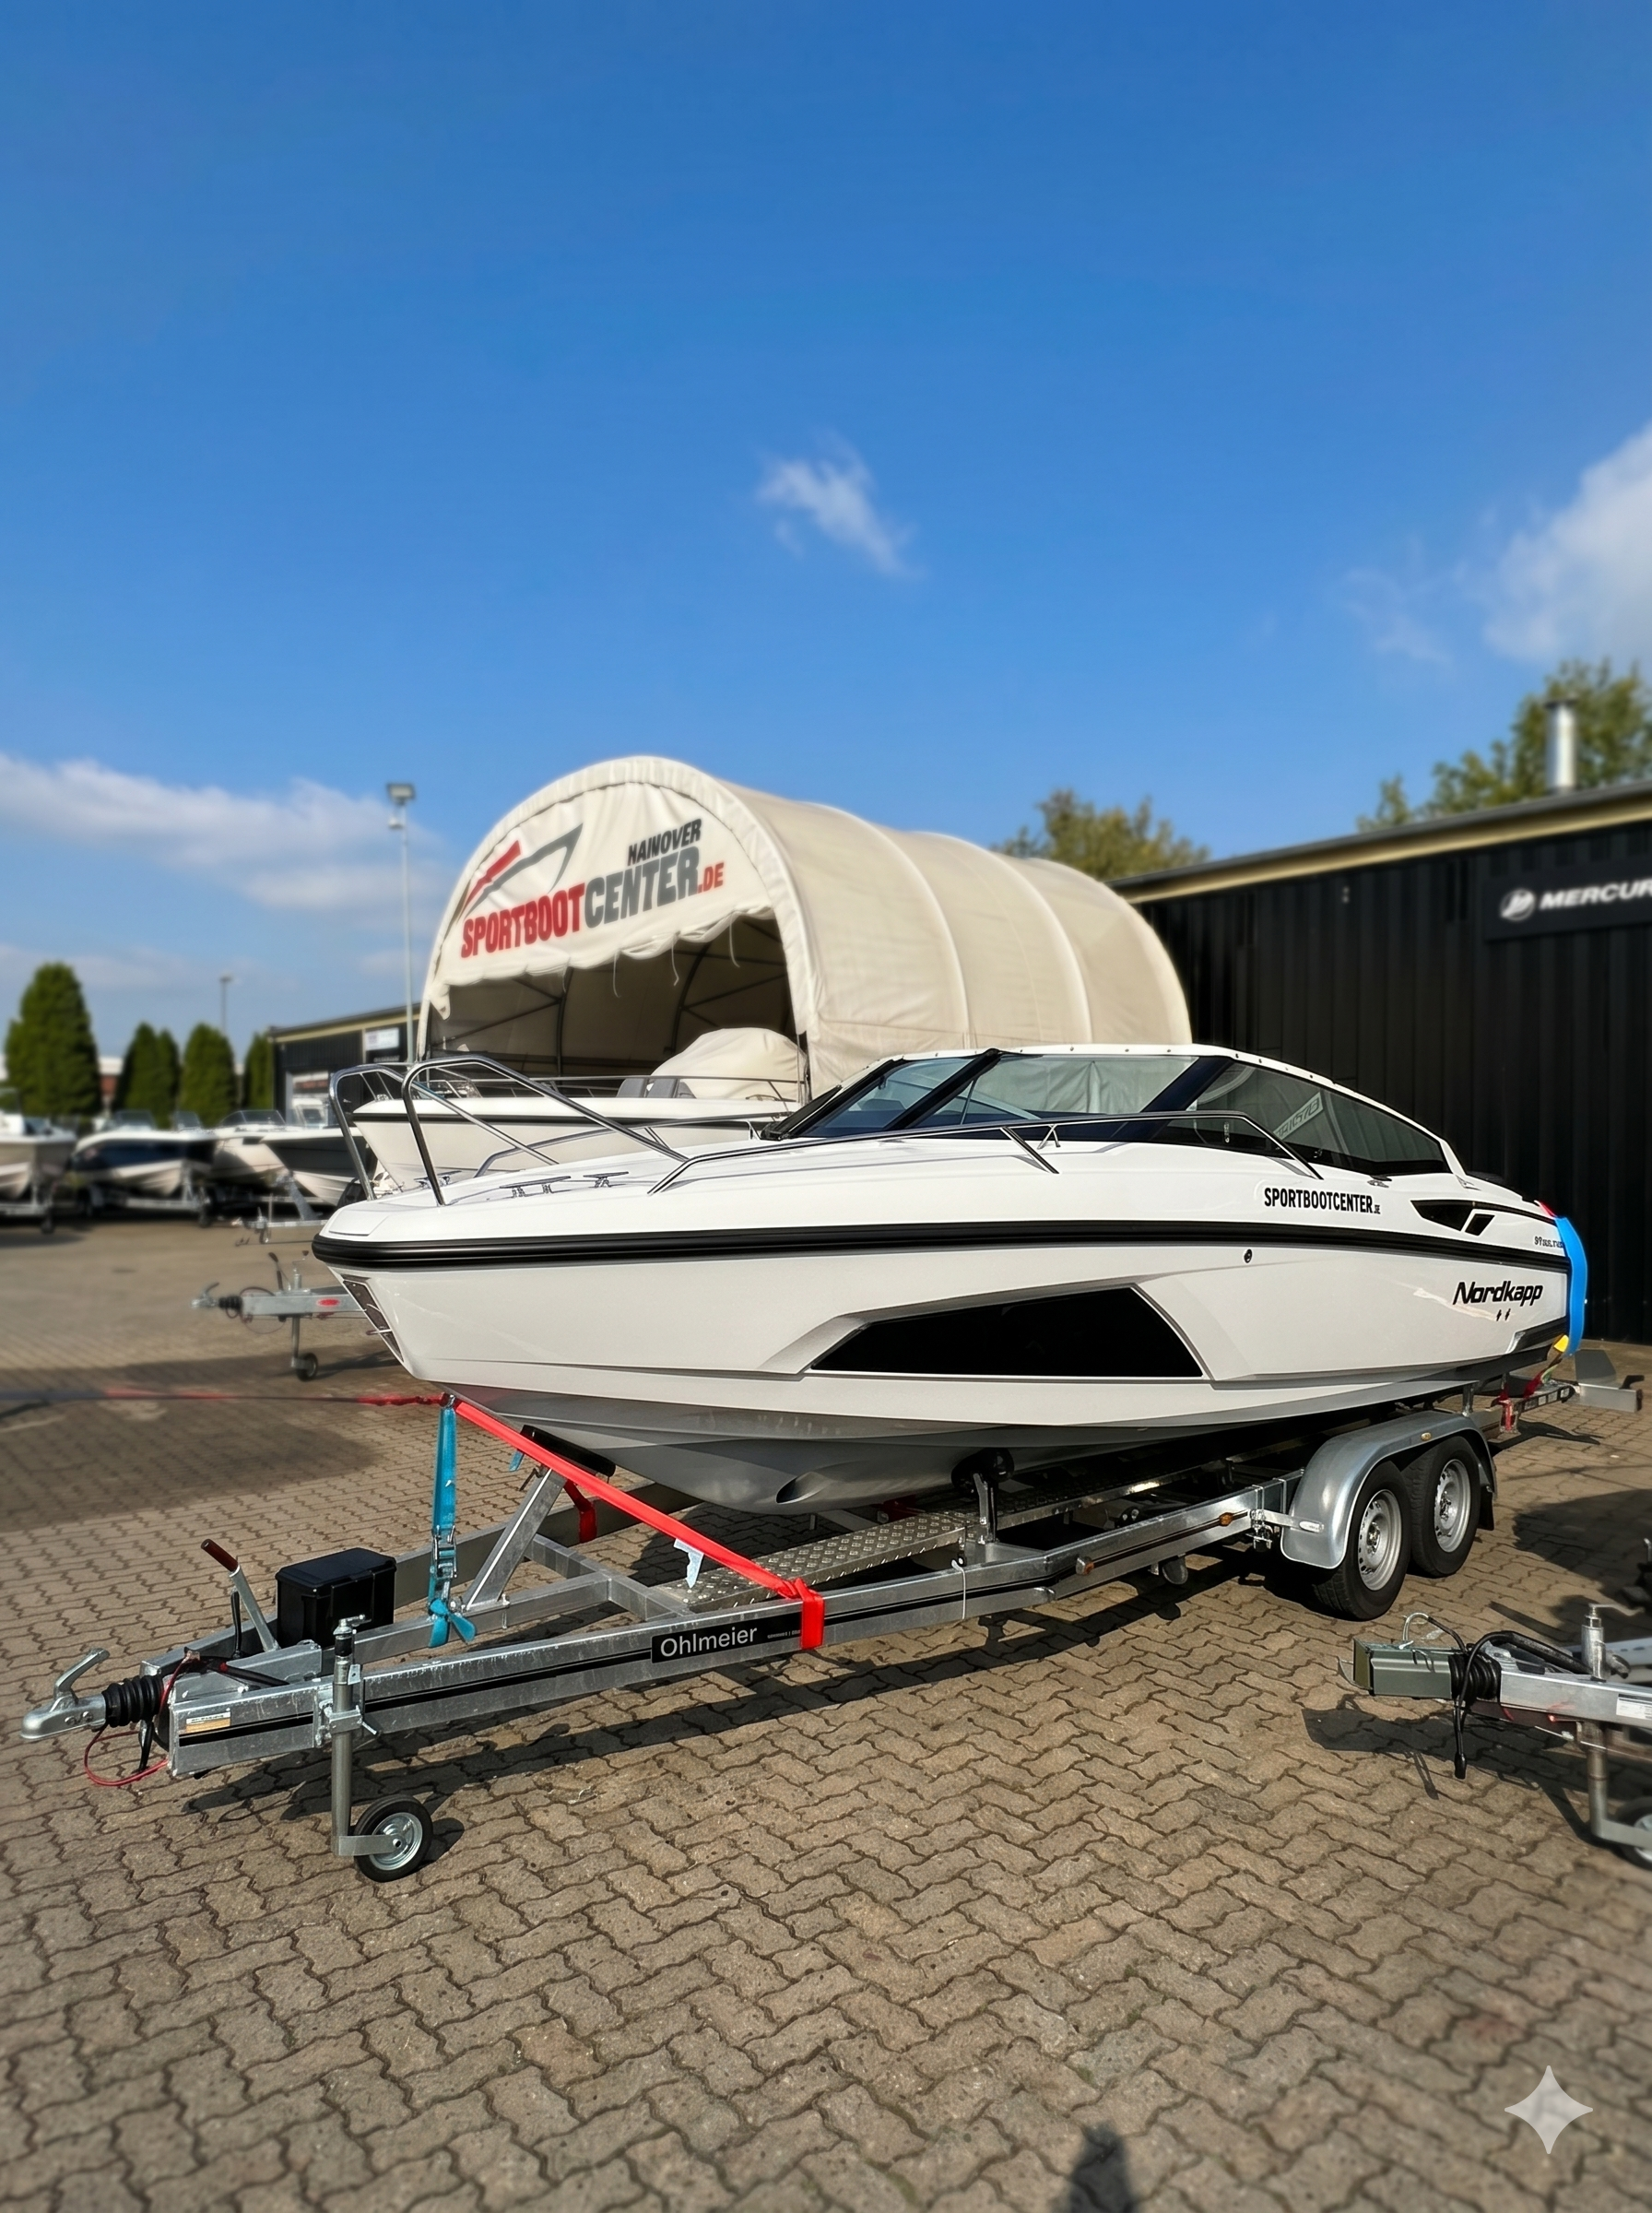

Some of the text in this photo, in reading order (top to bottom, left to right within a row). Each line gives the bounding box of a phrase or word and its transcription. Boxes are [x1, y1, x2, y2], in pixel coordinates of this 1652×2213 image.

[461, 846, 725, 958] SPORTBOOTCENTER.DE
[1452, 1280, 1544, 1308] Nordkapp
[660, 1627, 758, 1657] Ohlmeier
